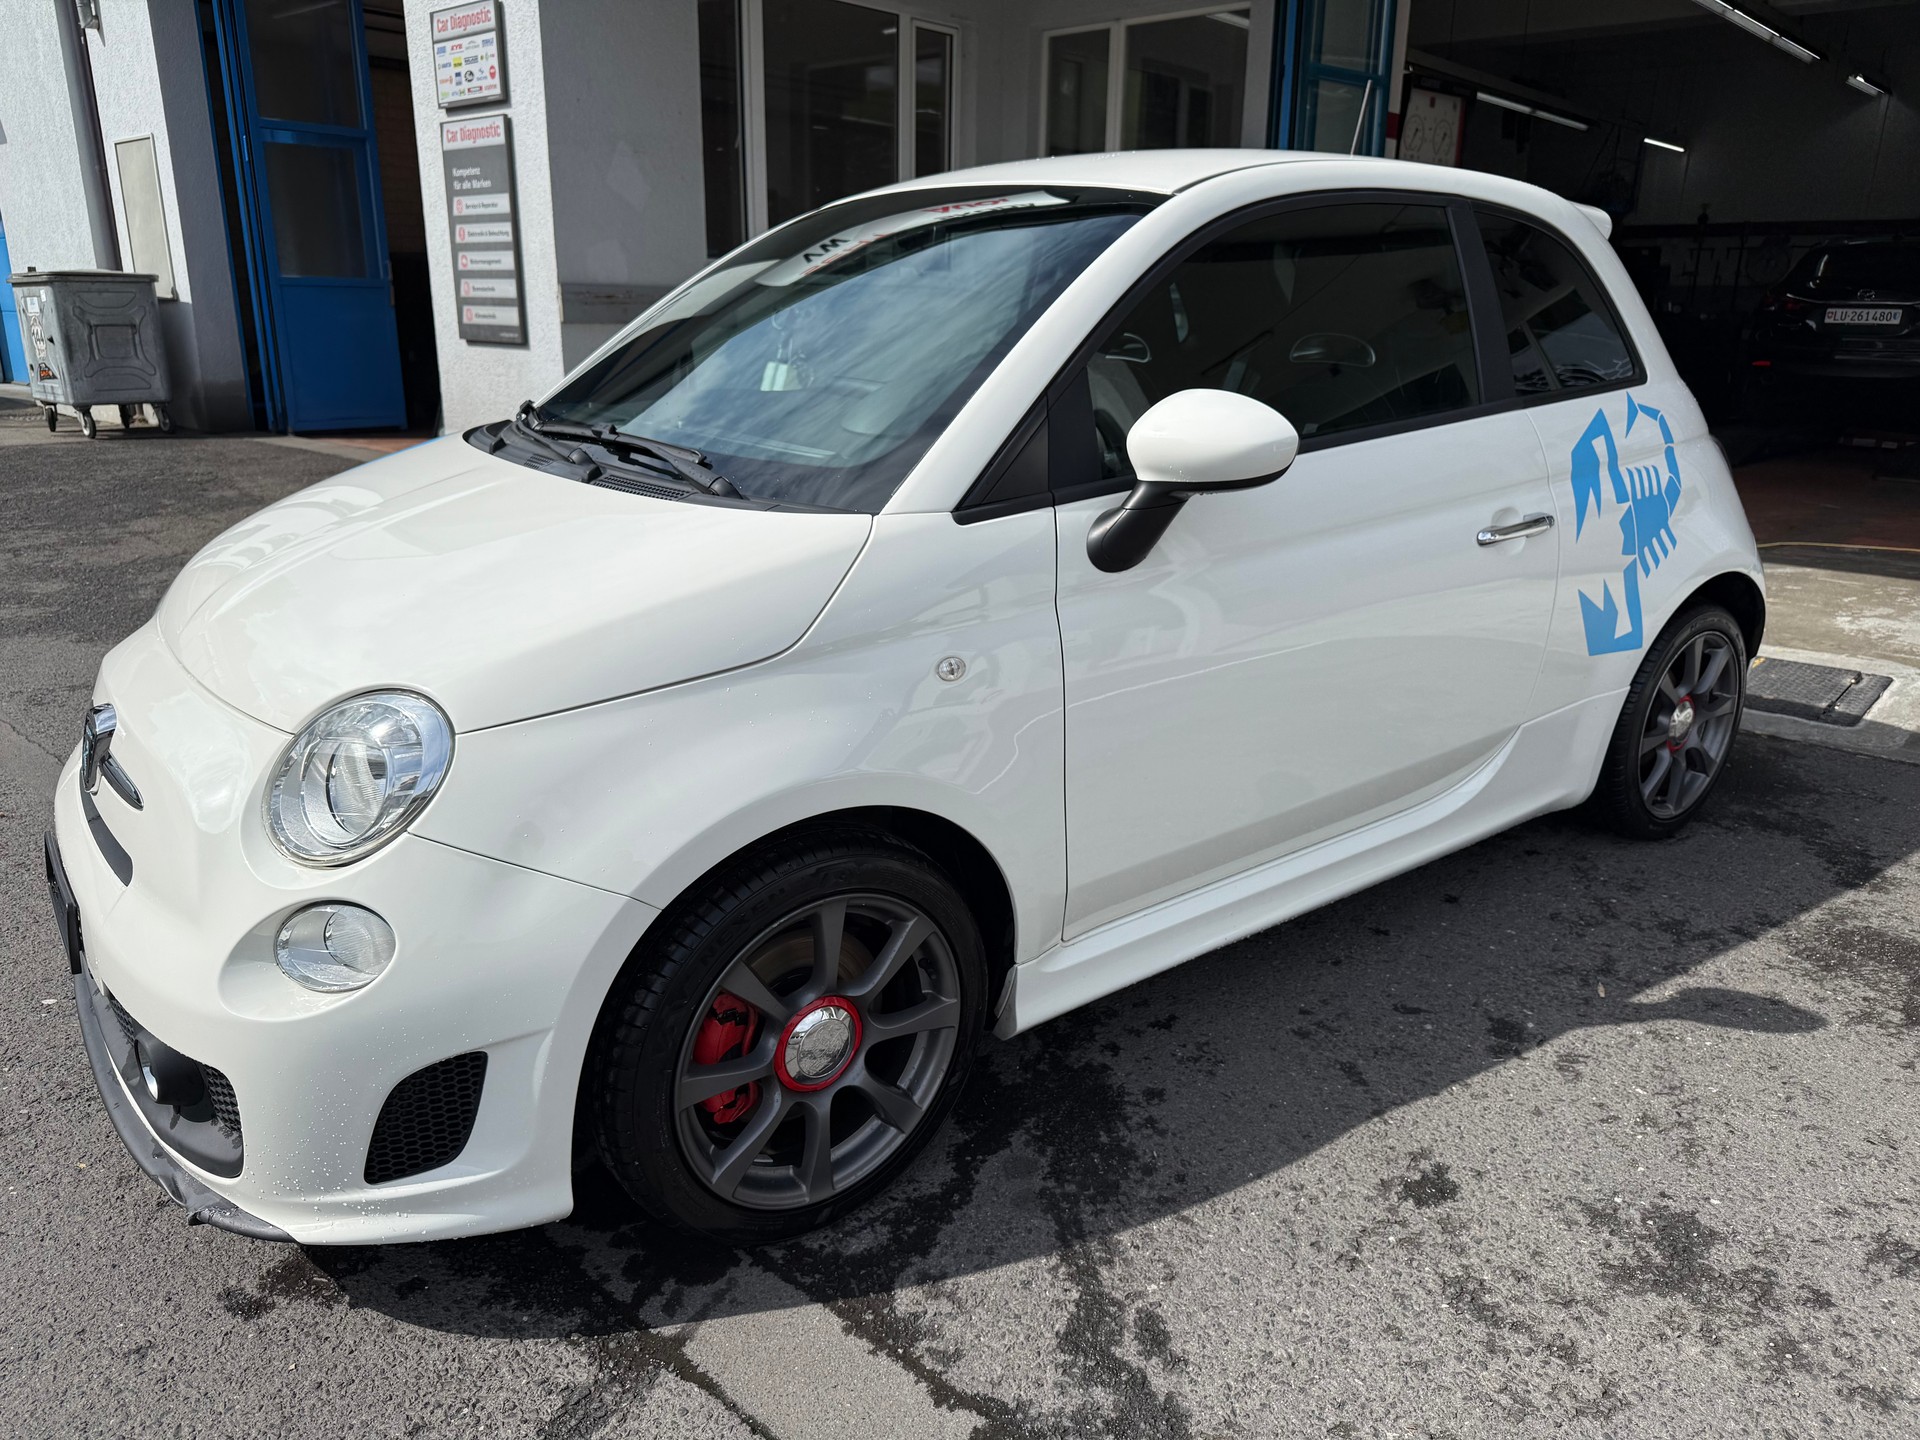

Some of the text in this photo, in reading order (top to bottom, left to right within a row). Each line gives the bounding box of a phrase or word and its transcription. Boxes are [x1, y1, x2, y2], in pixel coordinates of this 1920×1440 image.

[436, 6, 492, 33] Car Diagnostic
[445, 121, 501, 144] Car Diagnostic
